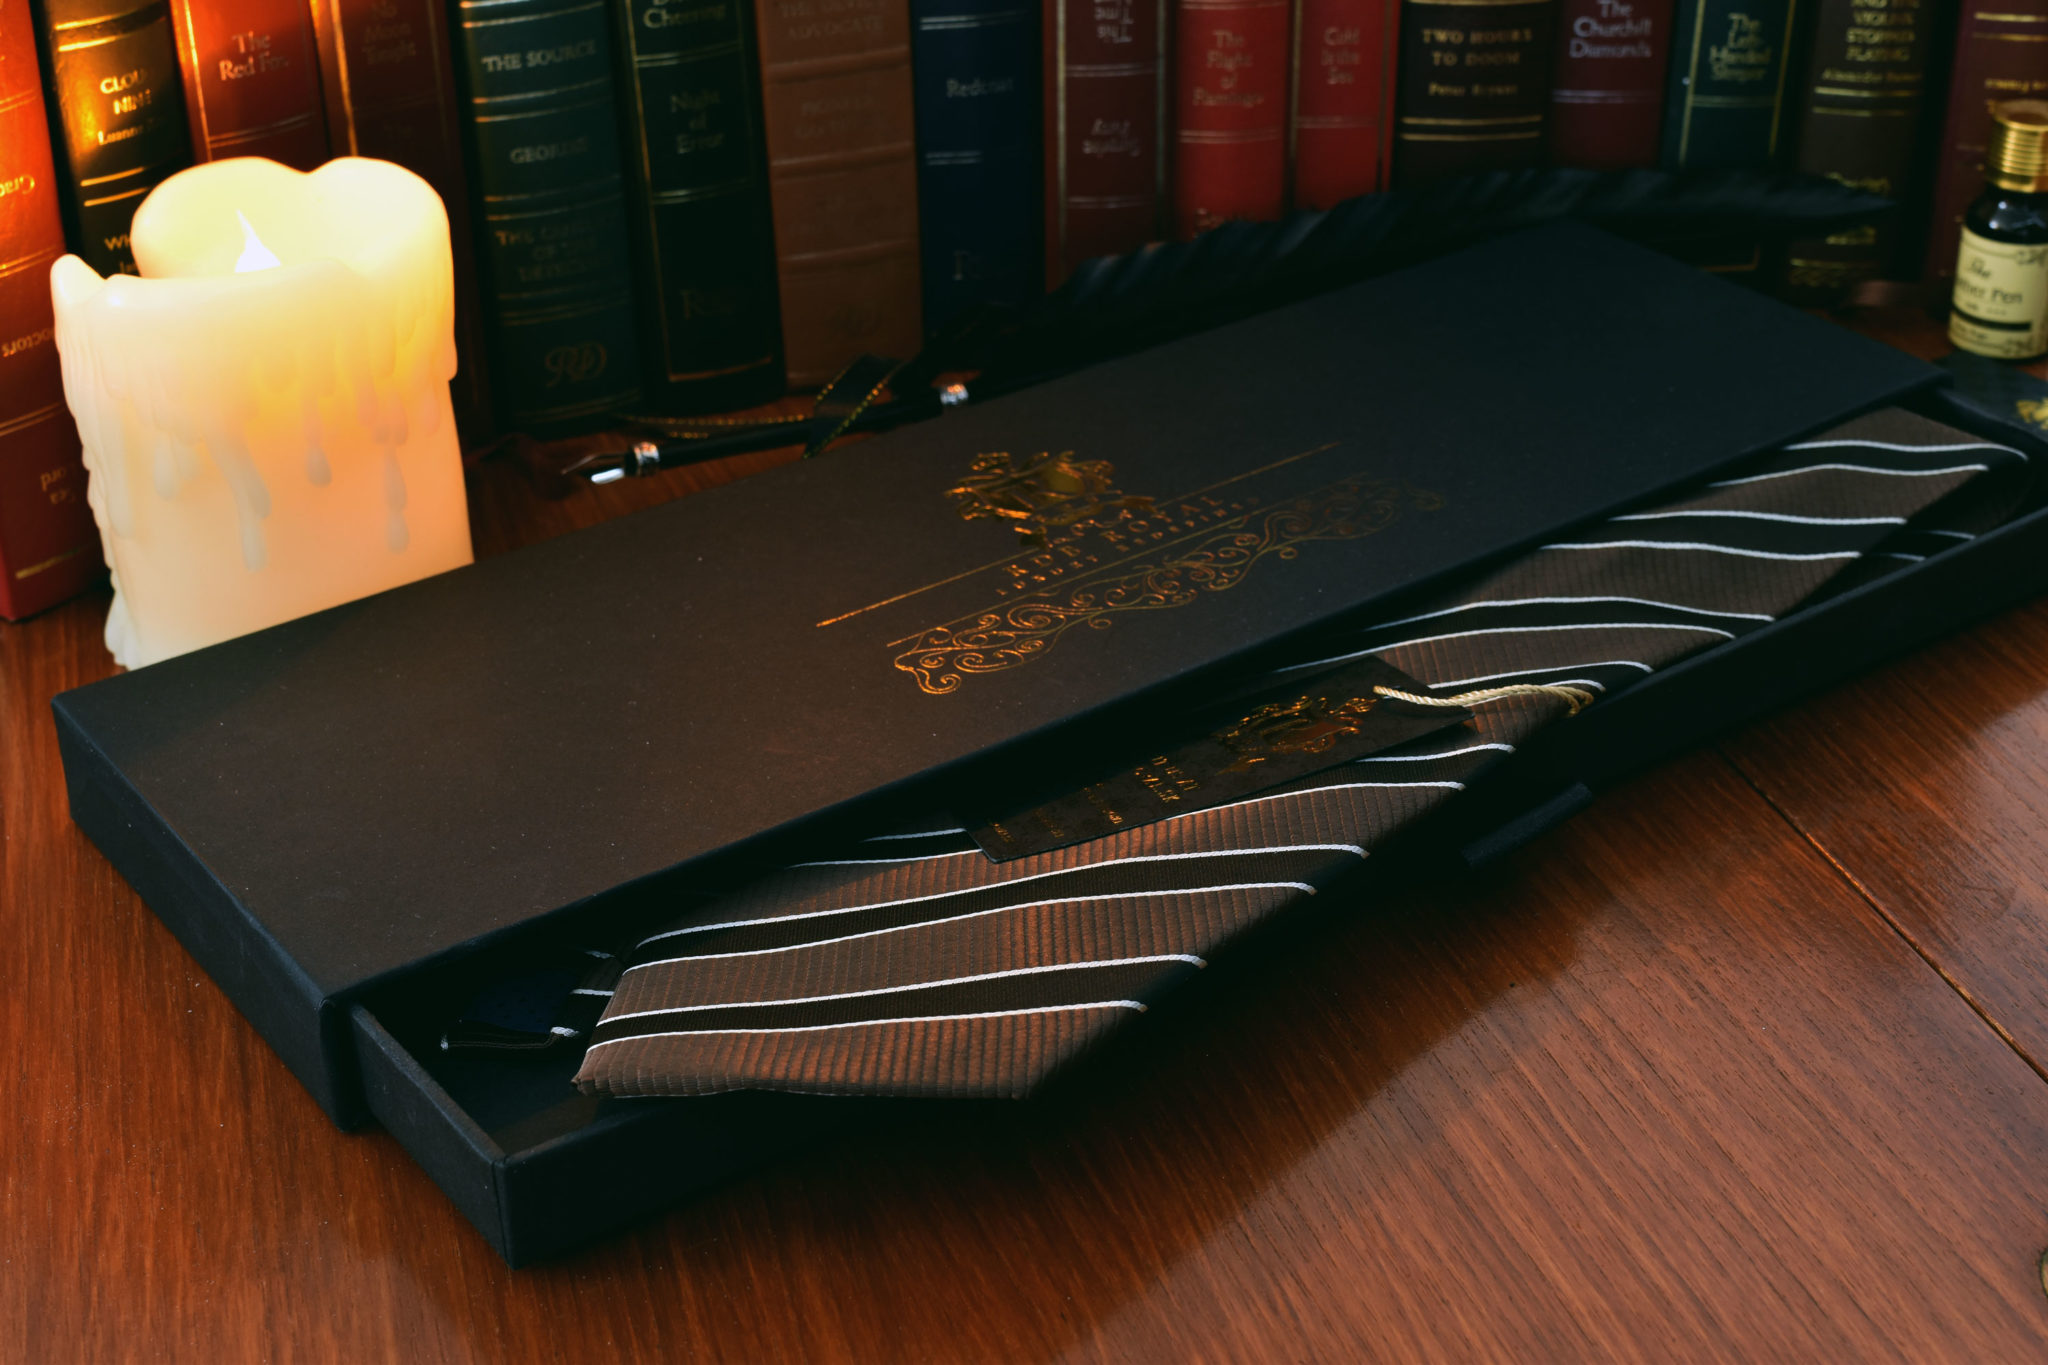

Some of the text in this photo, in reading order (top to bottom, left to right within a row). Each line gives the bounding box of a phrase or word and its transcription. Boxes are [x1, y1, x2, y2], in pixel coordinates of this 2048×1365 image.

[1597, 0, 1633, 18] The
[787, 15, 884, 40] ADVOCATE
[1422, 28, 1533, 44] TWO HOURS
[1572, 16, 1653, 38] Churchill
[231, 31, 271, 54] The
[1212, 30, 1245, 48] The
[1569, 37, 1652, 58] Diamonds
[481, 40, 595, 72] THE SOURCE
[1432, 50, 1458, 66] TO
[219, 56, 256, 81] Red
[1, 326, 55, 358] octors
[1100, 496, 1223, 543] ROYAL
